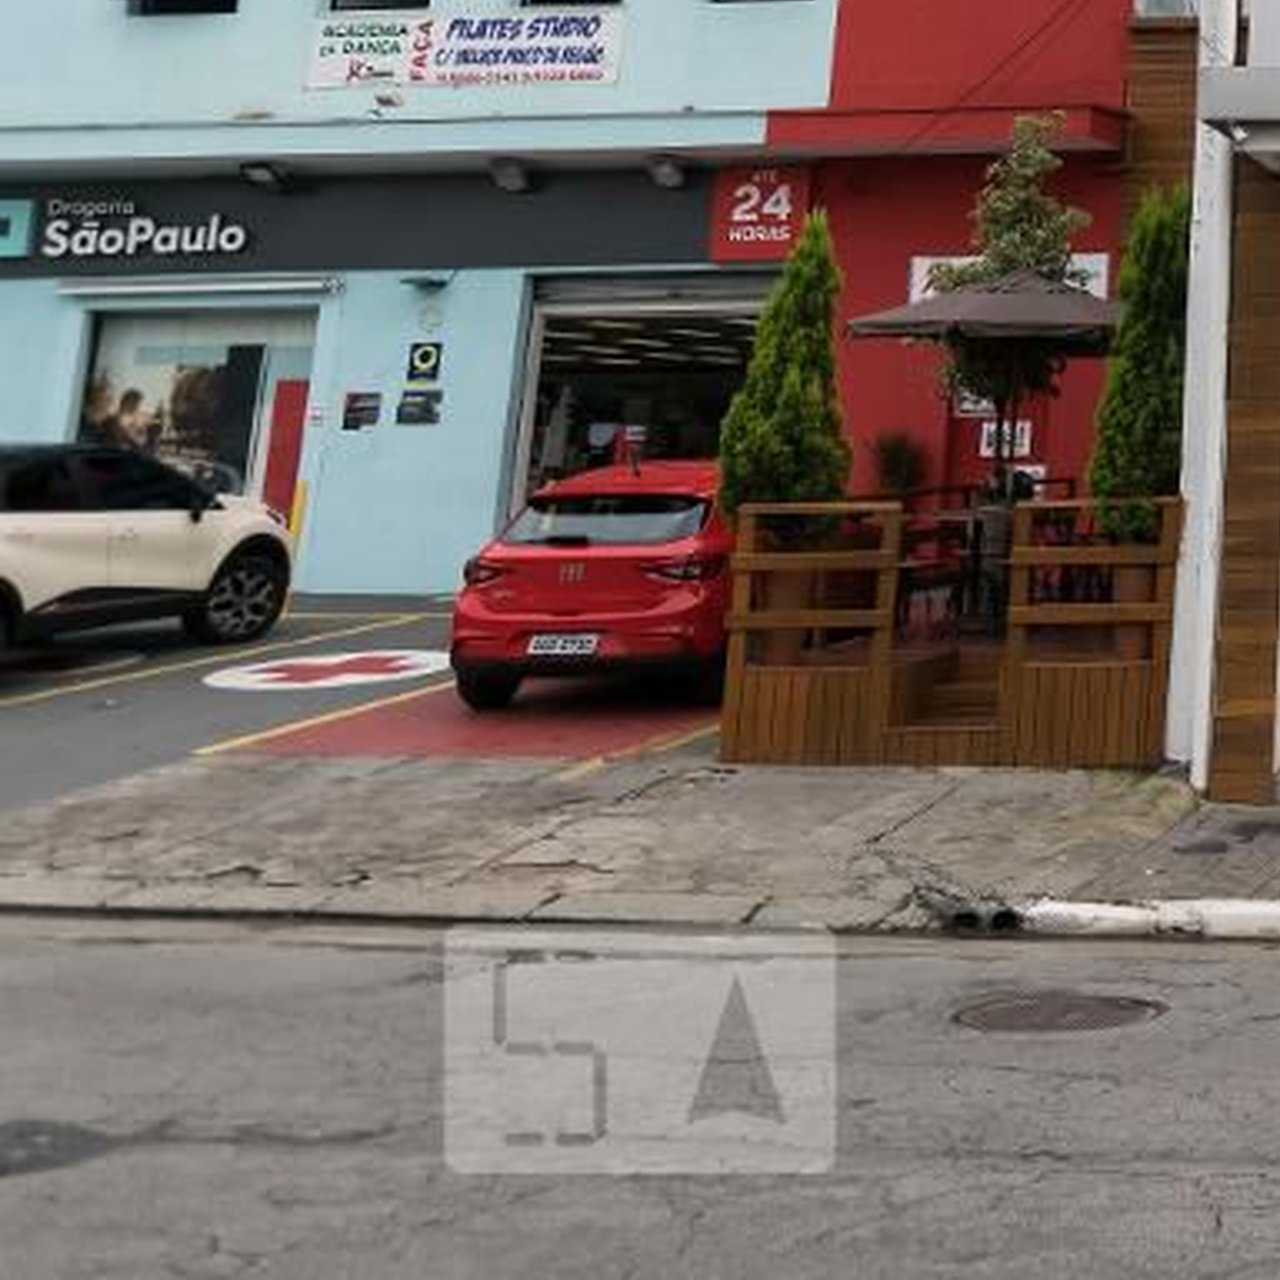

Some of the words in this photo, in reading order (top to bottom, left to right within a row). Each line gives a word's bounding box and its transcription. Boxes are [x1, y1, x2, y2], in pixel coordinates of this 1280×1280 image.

[526, 16, 601, 40] STUDIO
[48, 199, 136, 217] Drogaria
[731, 184, 792, 221] 24
[728, 225, 792, 241] HORAS
